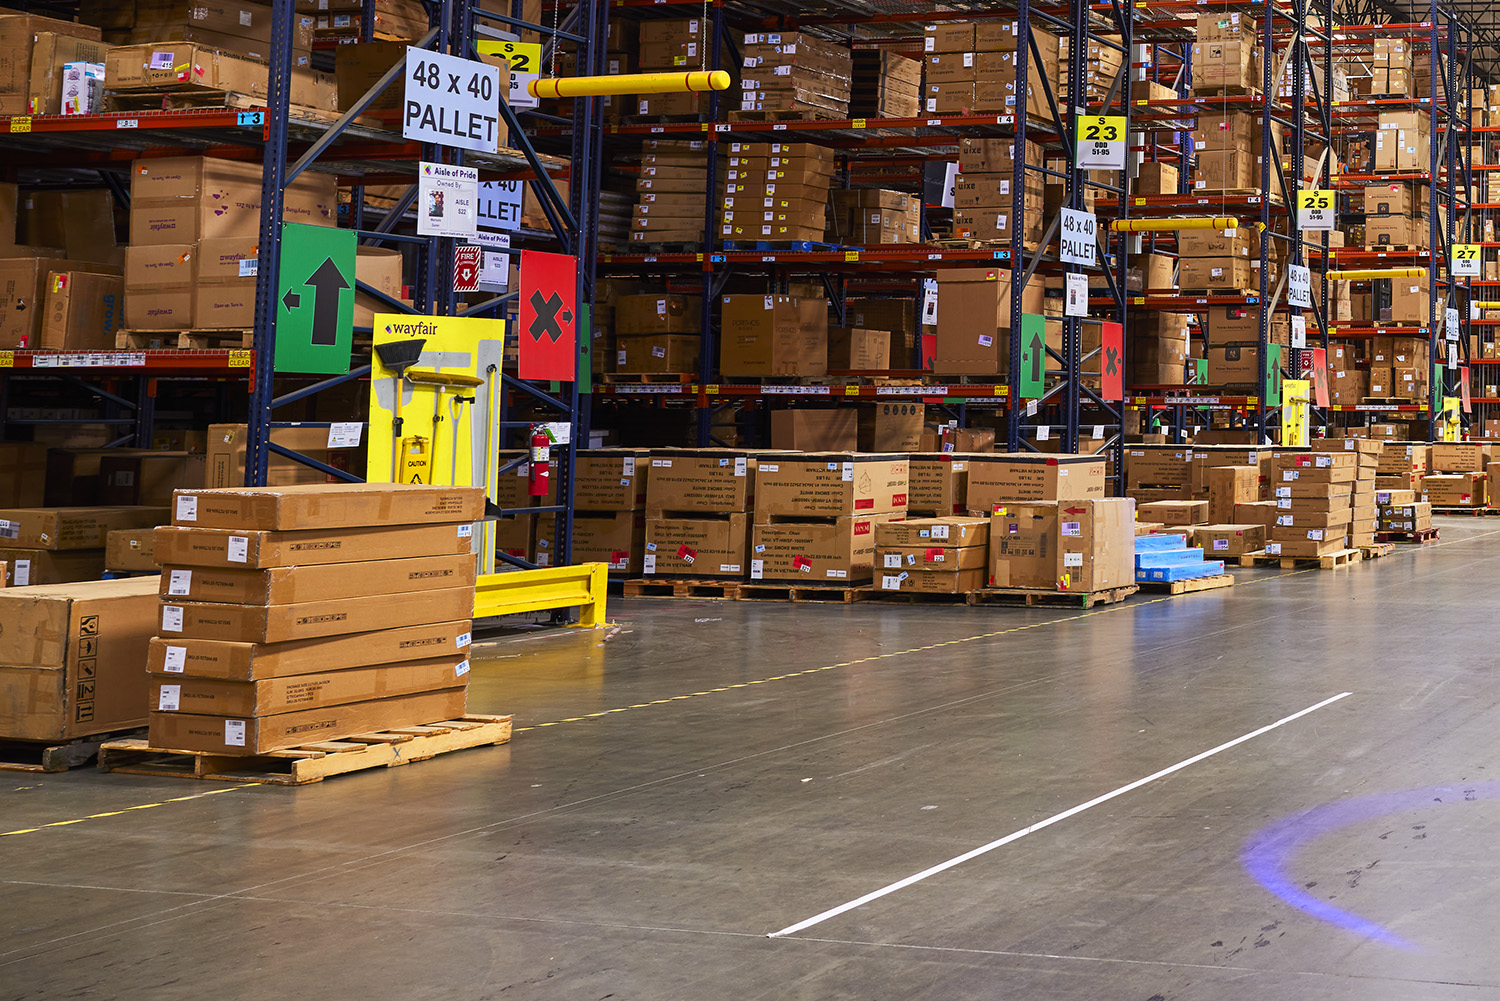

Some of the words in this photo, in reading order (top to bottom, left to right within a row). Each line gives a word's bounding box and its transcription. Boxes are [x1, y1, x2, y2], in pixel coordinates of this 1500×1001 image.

[504, 44, 514, 52] S
[224, 51, 240, 60] Double
[413, 61, 440, 90] 48
[447, 73, 460, 94] x
[468, 73, 492, 100] 40
[252, 112, 260, 124] 3
[406, 100, 498, 142] PALLET
[1086, 126, 1118, 140] 23
[434, 168, 450, 177] Aisle
[452, 169, 458, 178] of
[460, 170, 476, 180] Pride
[498, 181, 516, 192] 40
[1304, 198, 1328, 208] 25
[150, 224, 171, 232] wayfair
[1064, 216, 1074, 232] 48
[1084, 220, 1094, 236] 40
[1062, 239, 1096, 260] PALLET
[1457, 250, 1476, 259] 27
[1290, 270, 1298, 282] 48
[1302, 272, 1308, 284] 40
[1289, 288, 1310, 302] PALLET
[103, 294, 116, 337] grow.
[393, 322, 438, 337] wayfair
